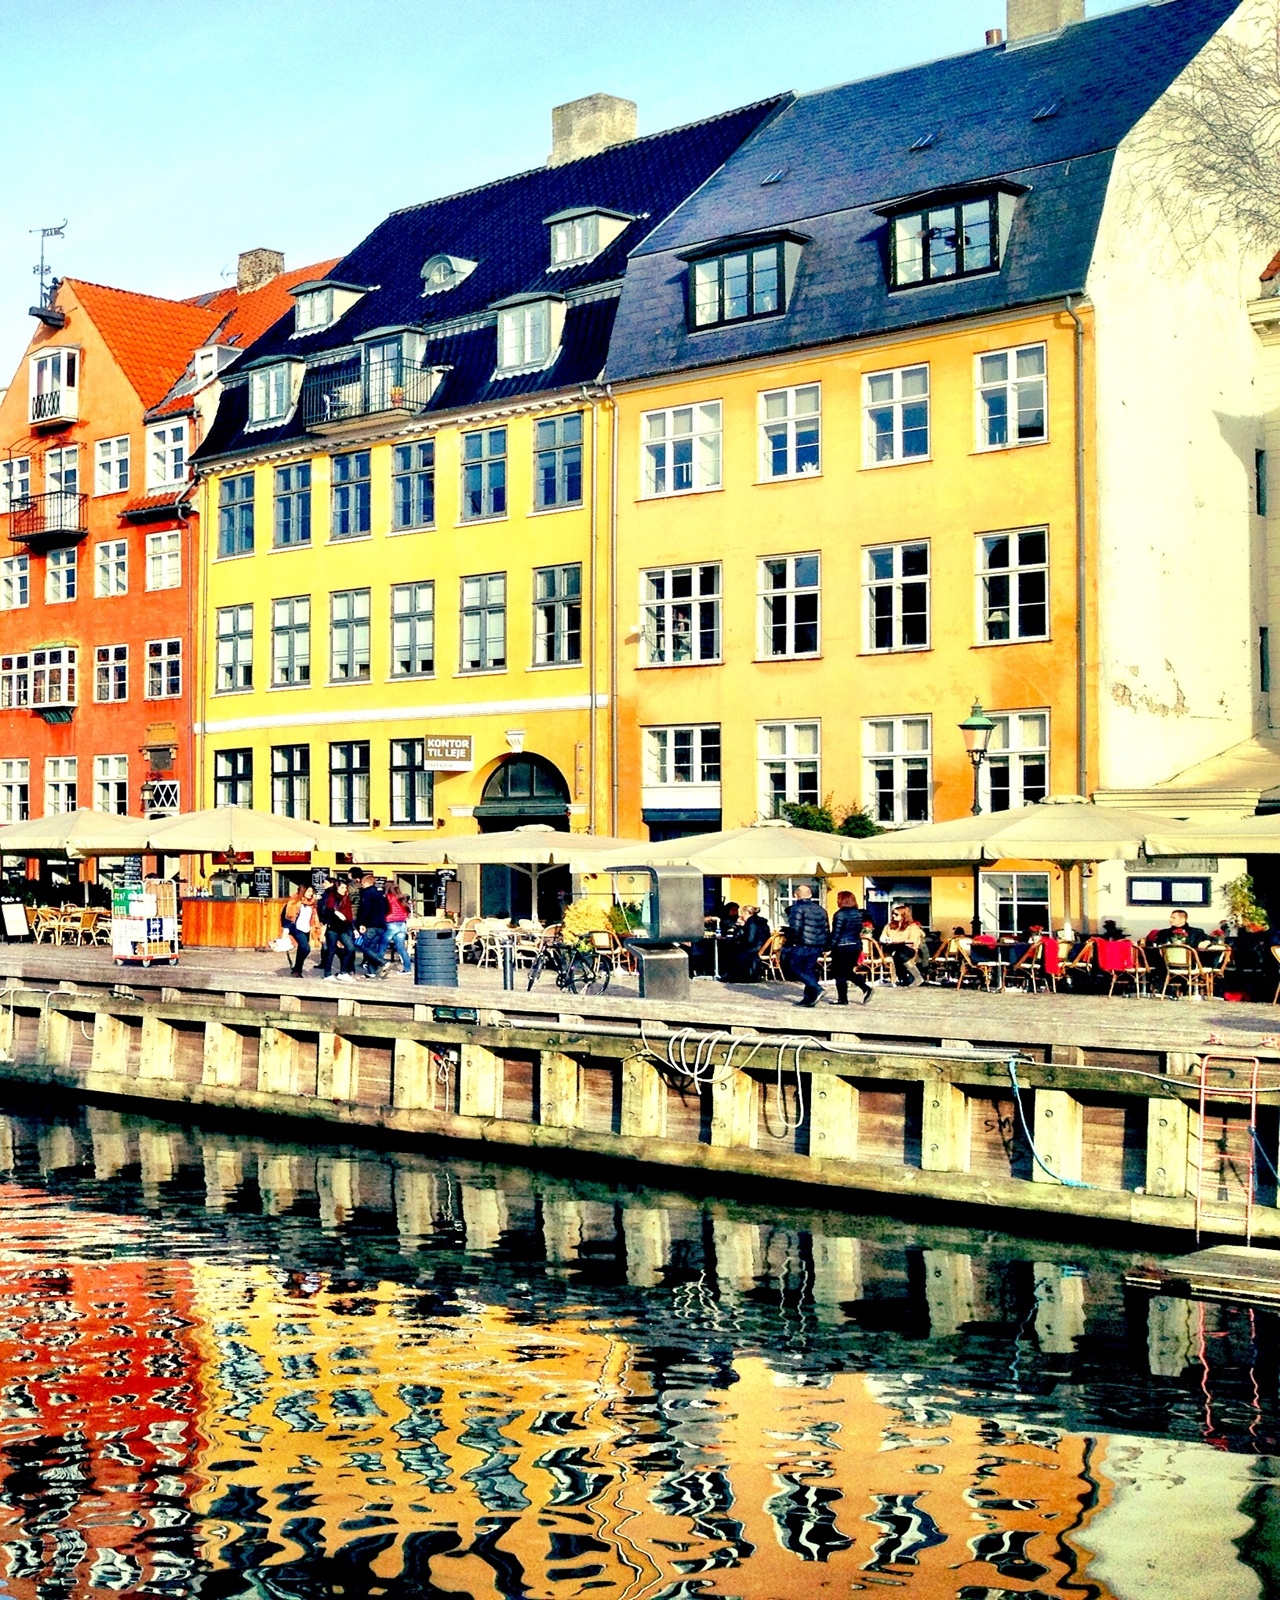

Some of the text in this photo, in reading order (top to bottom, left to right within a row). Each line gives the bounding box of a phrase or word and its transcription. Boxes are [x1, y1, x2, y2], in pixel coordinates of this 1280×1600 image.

[427, 739, 469, 748] KONTOR
[427, 748, 466, 759] TIL LEJE
